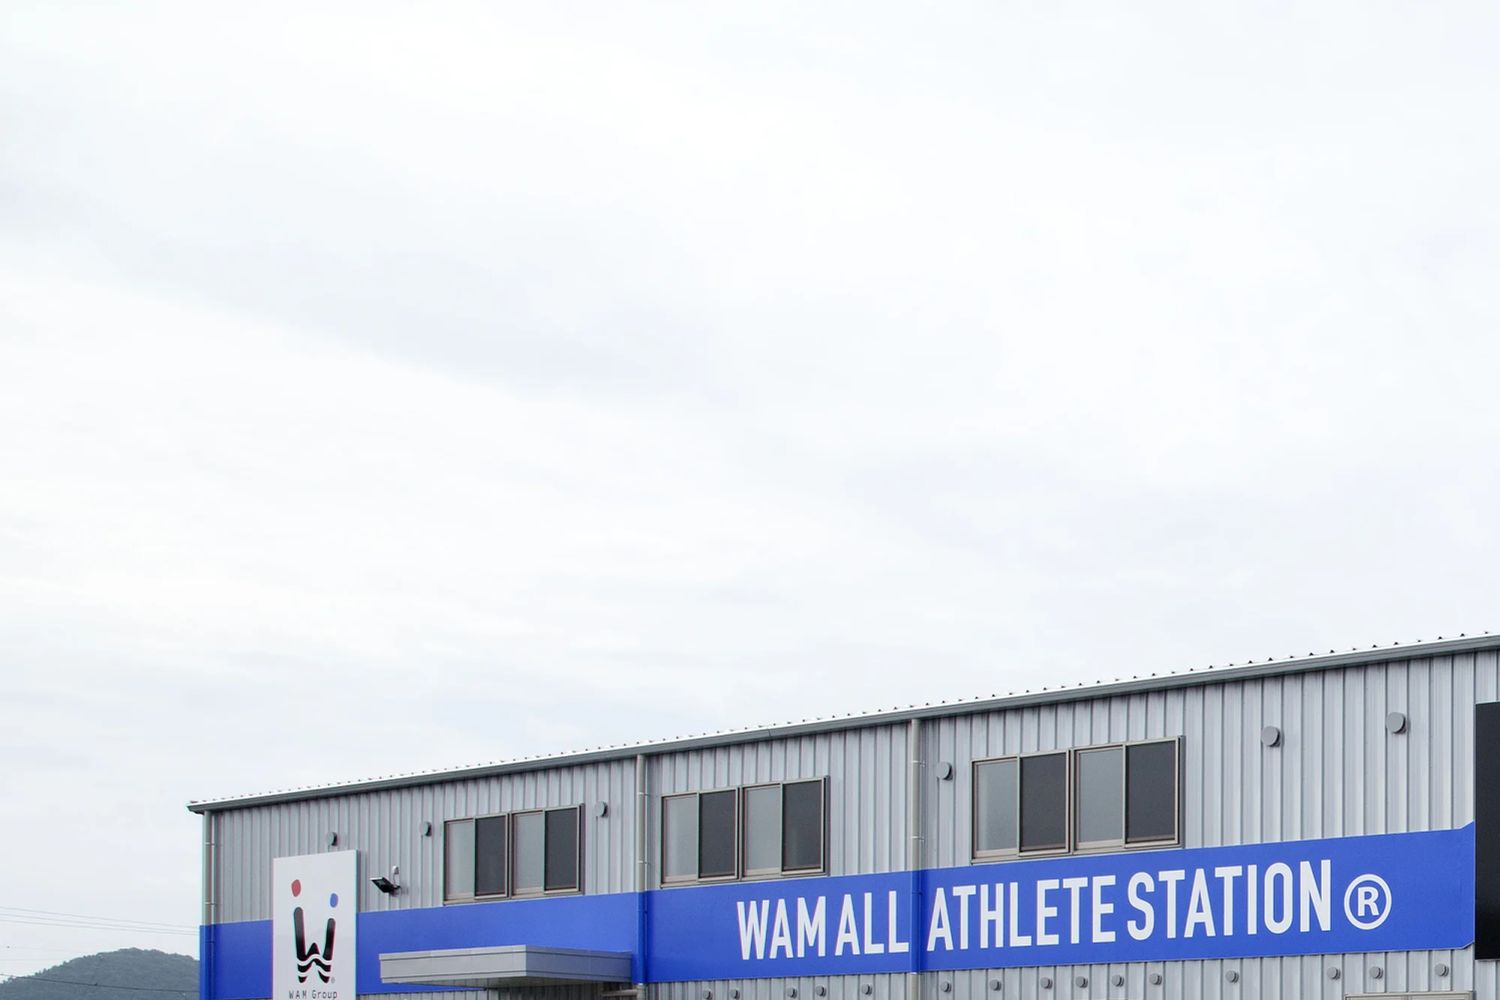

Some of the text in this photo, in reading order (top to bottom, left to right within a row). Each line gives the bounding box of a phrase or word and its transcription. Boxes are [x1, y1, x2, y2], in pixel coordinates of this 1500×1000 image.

[737, 895, 827, 961] WAM
[834, 890, 910, 957] ALL
[926, 874, 1116, 952] ATHLETE
[288, 989, 308, 1000] WAM
